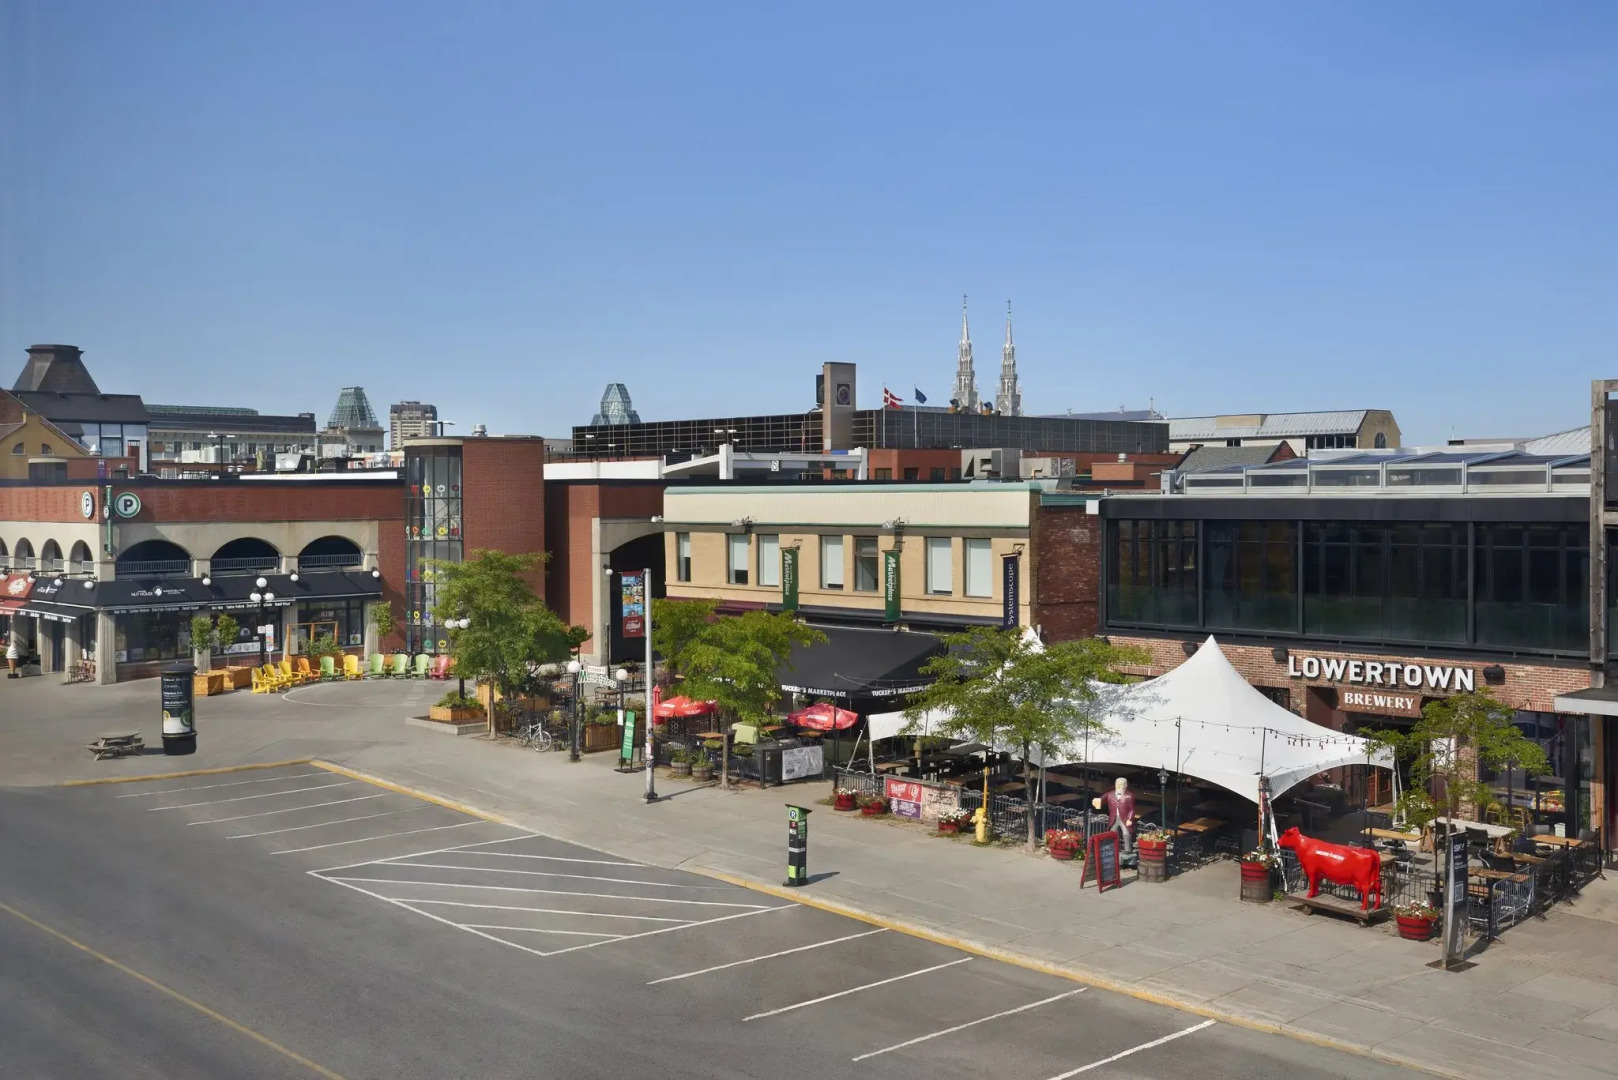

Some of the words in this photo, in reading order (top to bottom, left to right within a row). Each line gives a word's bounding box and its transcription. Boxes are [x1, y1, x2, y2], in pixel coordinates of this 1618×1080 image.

[123, 498, 134, 512] P
[783, 552, 793, 596] Marketplace
[886, 555, 896, 602] Marketplace
[320, 610, 335, 618] ATM
[1288, 655, 1475, 691] LOWERTOWN
[1344, 692, 1415, 710] BREWERY
